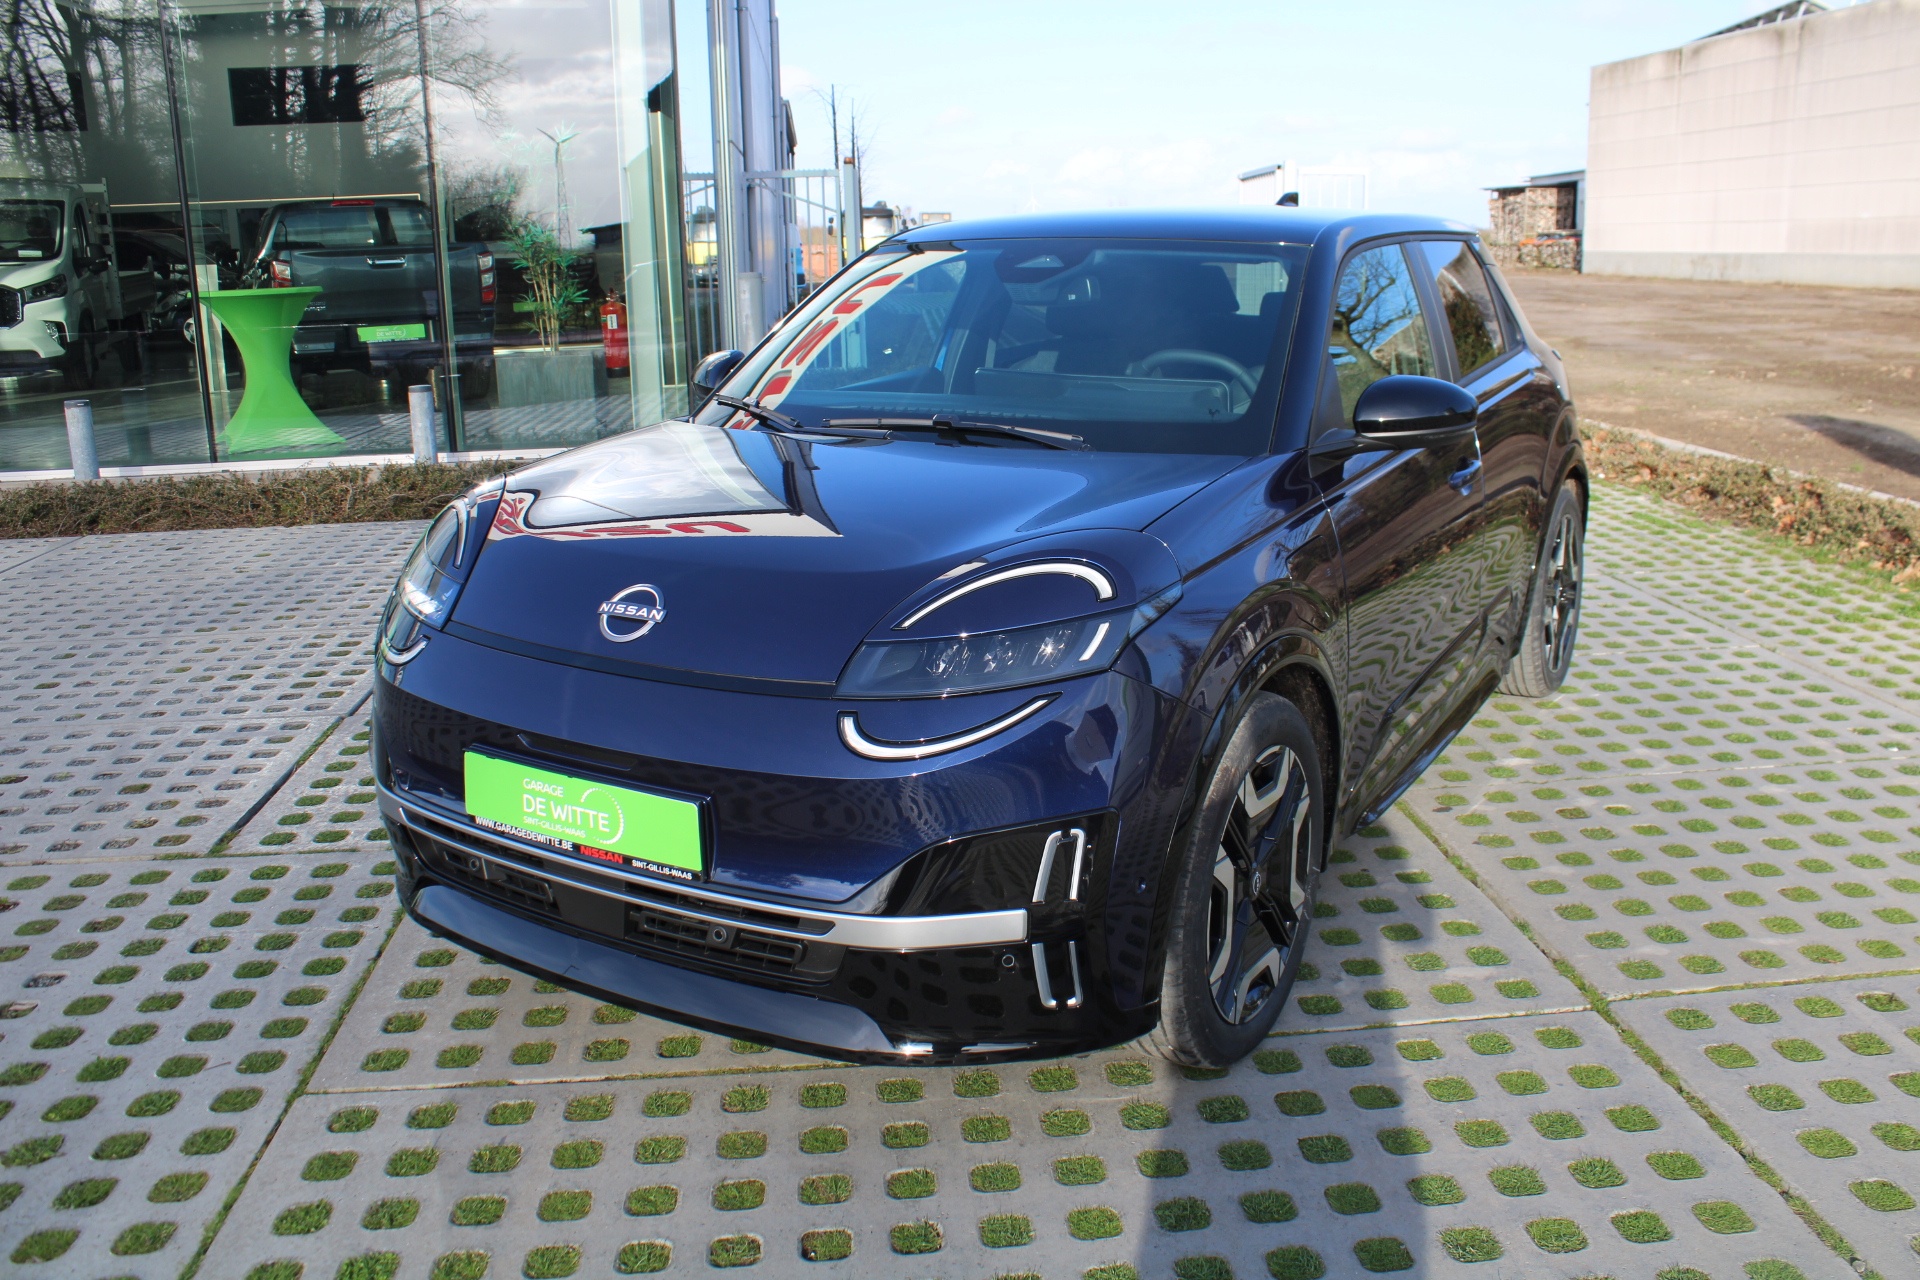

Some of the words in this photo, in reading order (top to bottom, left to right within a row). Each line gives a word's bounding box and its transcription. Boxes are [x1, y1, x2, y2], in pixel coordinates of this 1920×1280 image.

[599, 602, 664, 620] NISSAN
[523, 778, 564, 798] GARAGE
[523, 794, 546, 817] DE
[550, 800, 610, 832] WITTE
[475, 815, 573, 851] WWW.GARAGEDEWITTE.BE
[523, 815, 586, 838] SINT-GILLIS-WAAS
[580, 845, 623, 864] NISSAN
[631, 859, 693, 880] SINT-GILLIS-WAAS
